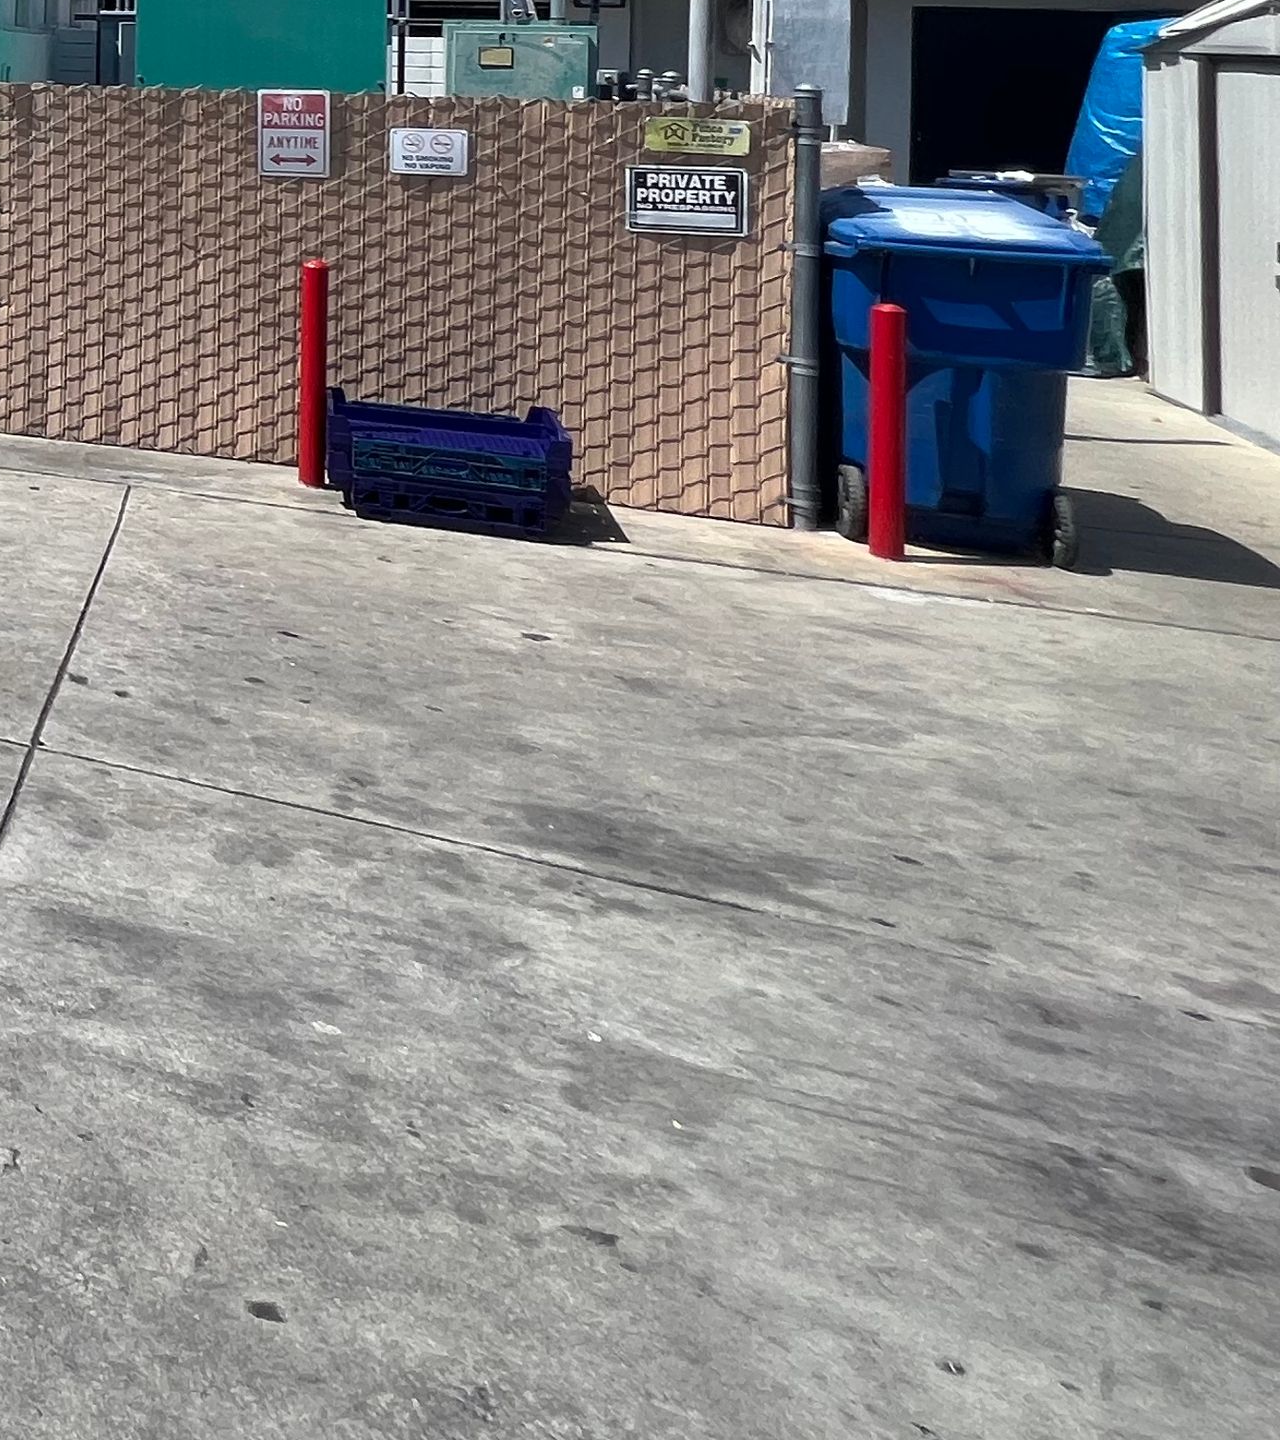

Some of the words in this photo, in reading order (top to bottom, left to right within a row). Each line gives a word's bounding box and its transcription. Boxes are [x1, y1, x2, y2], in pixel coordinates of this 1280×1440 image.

[283, 96, 302, 111] NO
[263, 112, 324, 127] PARKING
[267, 135, 320, 149] ANYTIME
[646, 173, 727, 190] PRIVATE
[636, 187, 736, 205] PROPERTY
[656, 203, 736, 212] TRESPASSING
